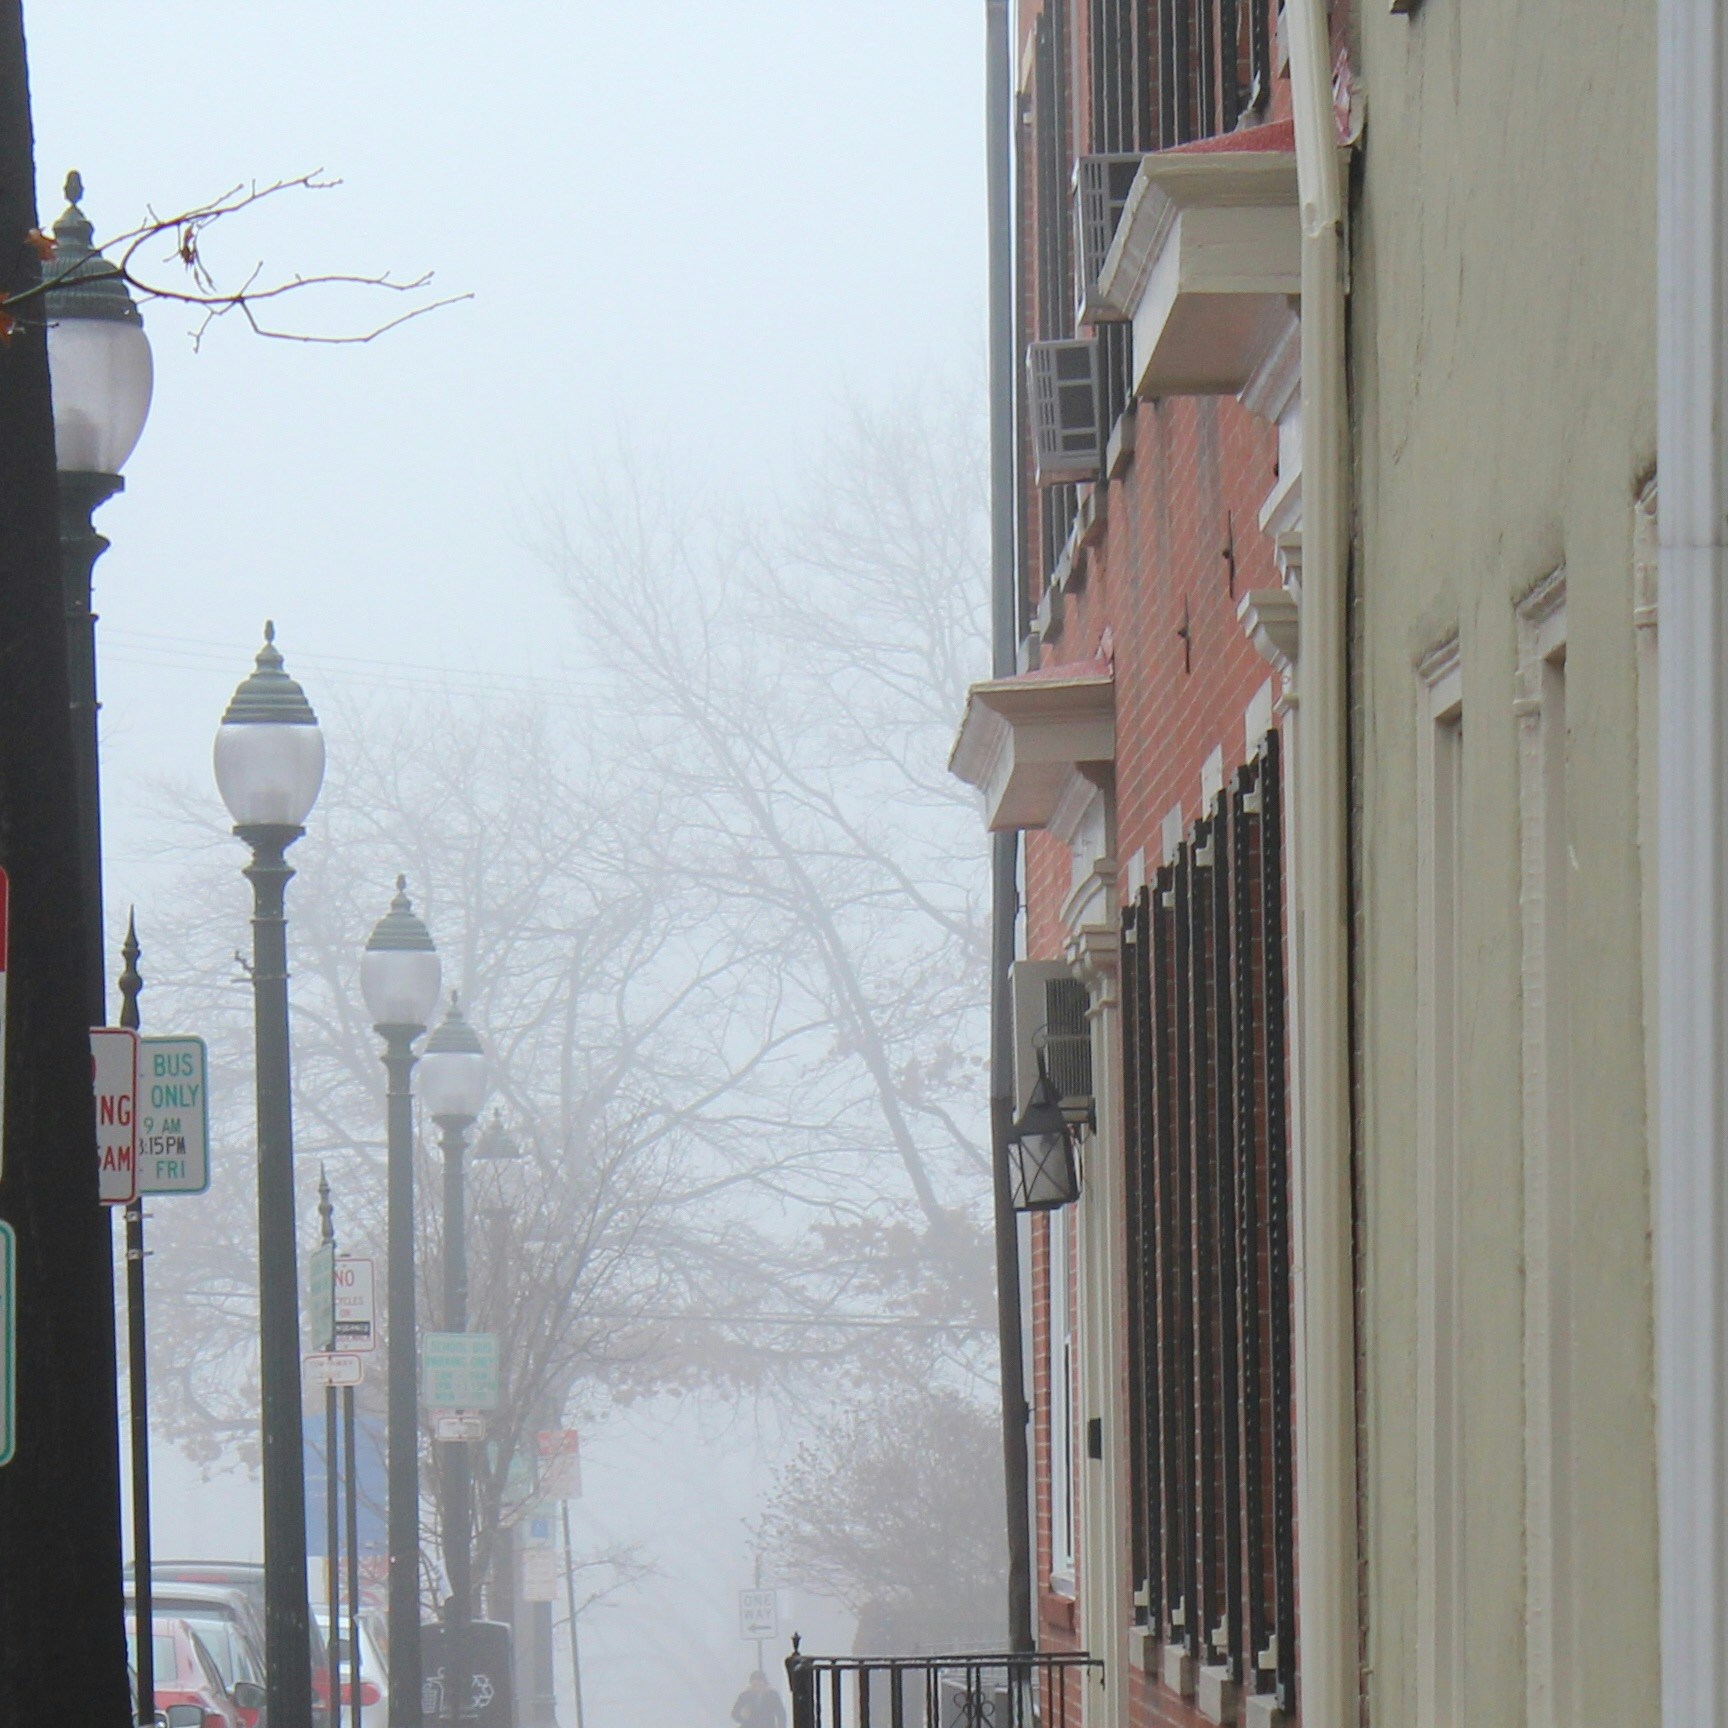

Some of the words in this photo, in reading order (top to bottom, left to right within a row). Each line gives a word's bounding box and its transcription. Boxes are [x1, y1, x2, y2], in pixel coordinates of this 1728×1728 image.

[154, 1053, 194, 1078] BUS
[151, 1085, 200, 1109] ONLY
[156, 1160, 186, 1180] FRI
